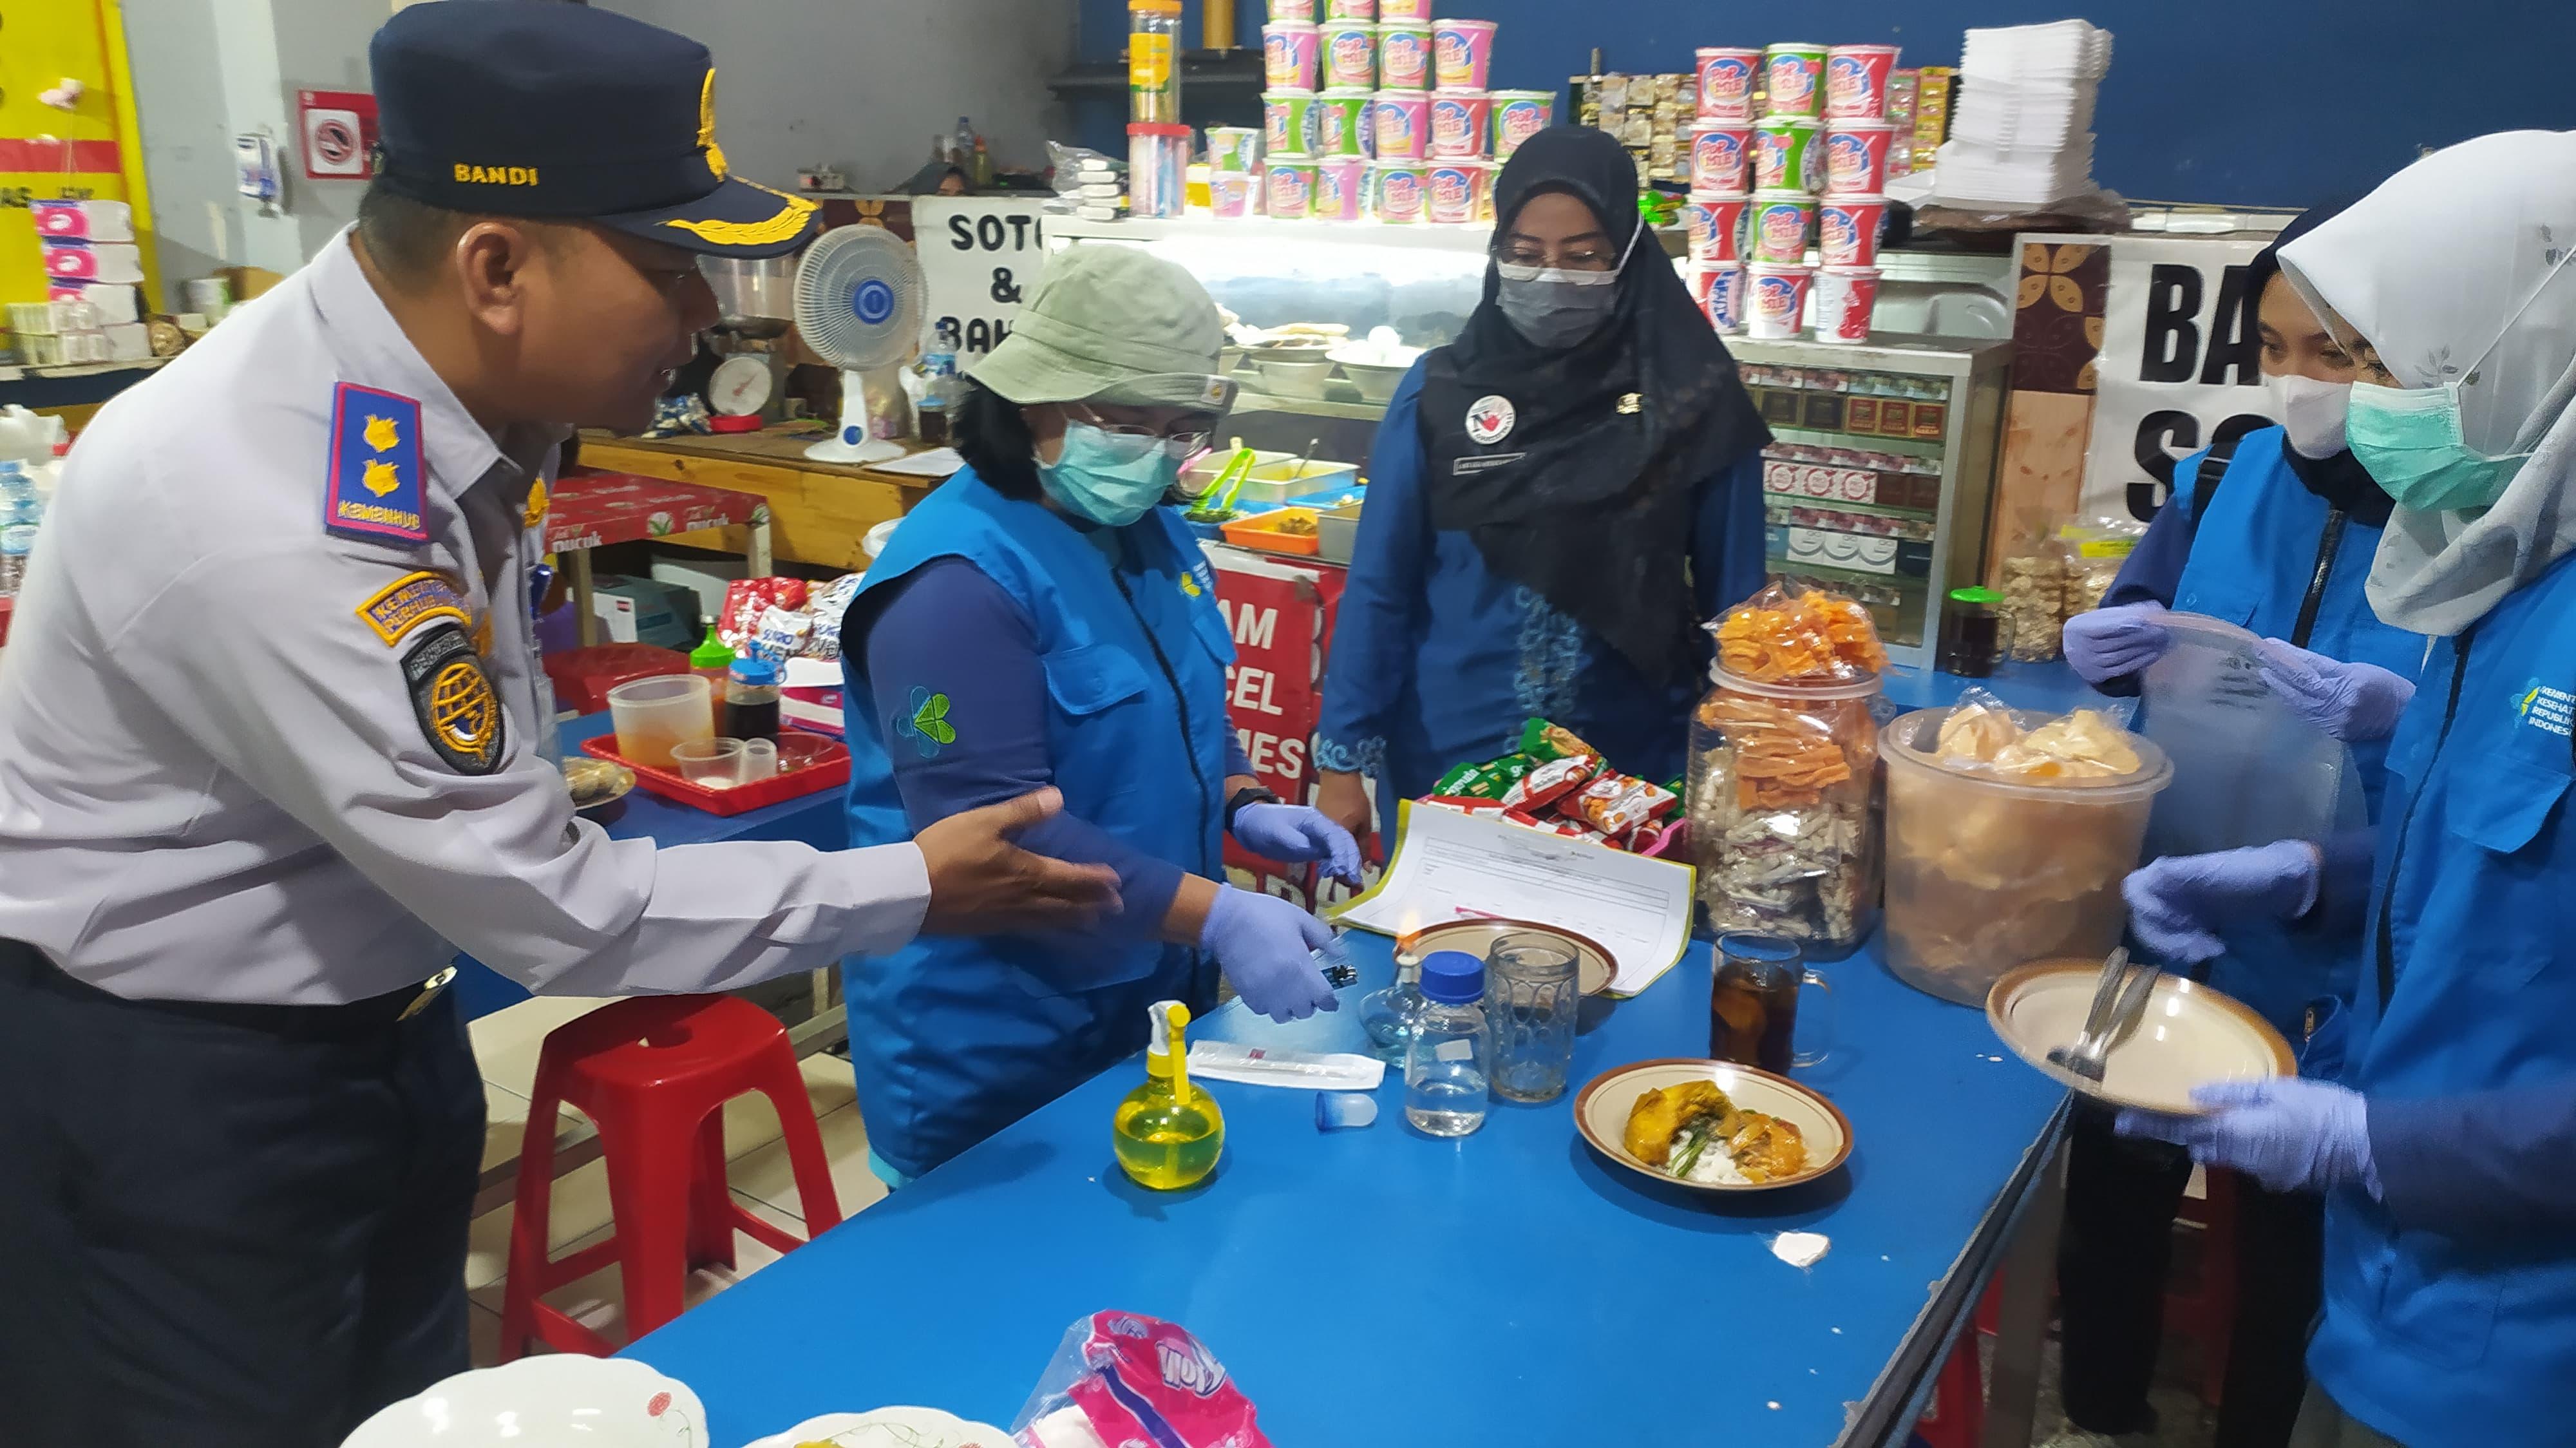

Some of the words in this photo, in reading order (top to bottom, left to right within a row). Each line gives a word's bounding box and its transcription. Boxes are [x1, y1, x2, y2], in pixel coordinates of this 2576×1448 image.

[453, 162, 540, 187] BANDI
[990, 267, 1022, 303] &
[2139, 263, 2263, 386] BA
